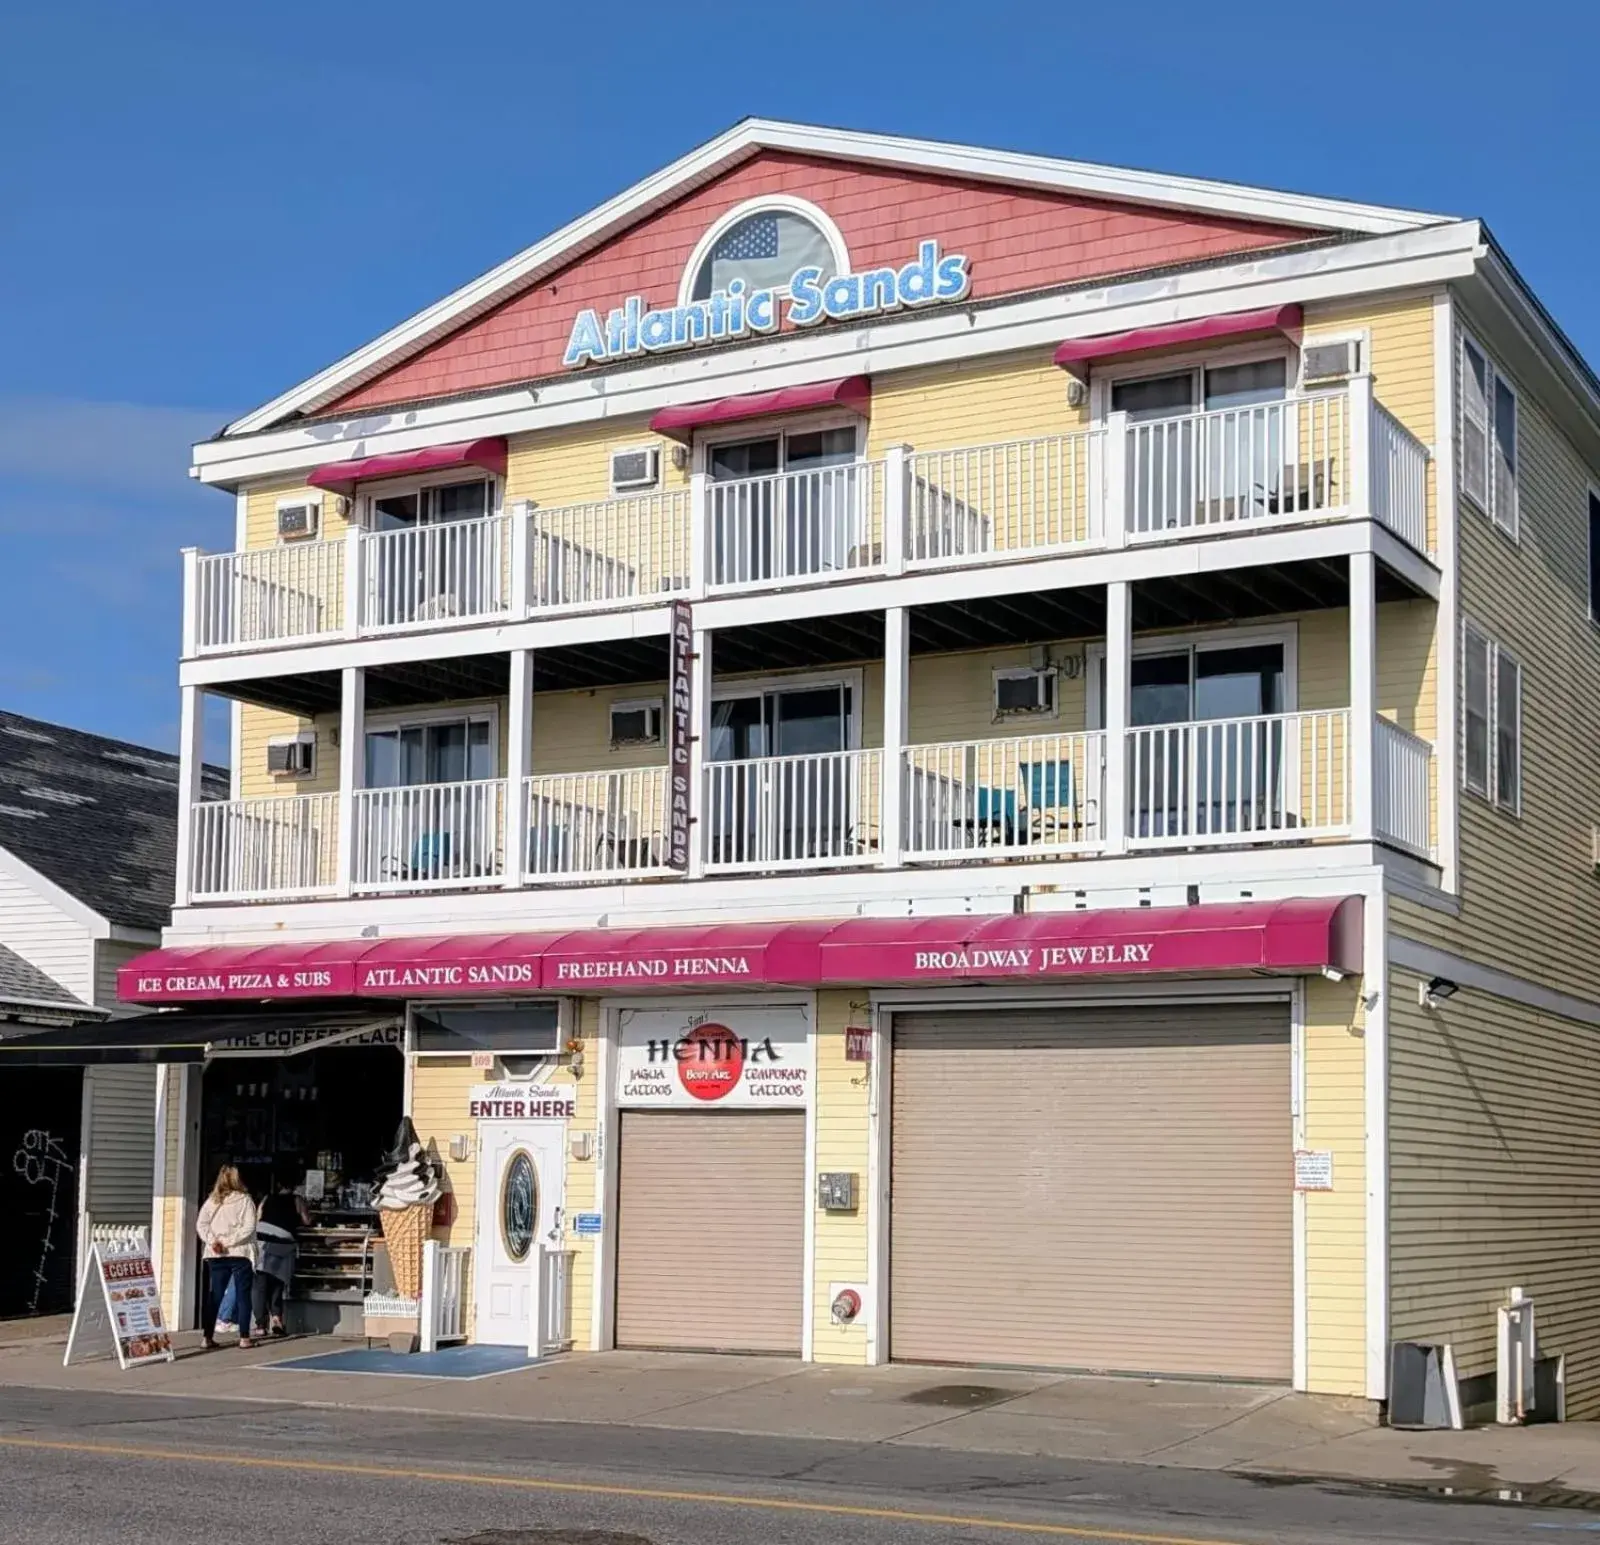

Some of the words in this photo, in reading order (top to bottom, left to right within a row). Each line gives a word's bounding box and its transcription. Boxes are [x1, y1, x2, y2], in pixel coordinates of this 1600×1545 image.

[562, 277, 777, 366] Atlantic
[787, 239, 970, 326] Sands
[673, 621, 690, 764] ATLANTIC
[672, 776, 688, 865] SANDS
[914, 948, 1034, 969] BROADWAY
[1039, 943, 1154, 971] JEWELRY
[364, 966, 462, 987] ATLANTIC
[468, 964, 532, 983] SANDS
[557, 959, 668, 980] FREEHAND
[674, 957, 750, 977] HENNA
[138, 977, 162, 992] ICE
[166, 976, 225, 993] CREAM,
[228, 974, 274, 990] PIZZA
[276, 974, 289, 988] &
[294, 971, 331, 987] SUBS
[647, 1037, 782, 1062] HENNA
[745, 1068, 807, 1081] TEMPORARY
[485, 1085, 525, 1099] Atlantic
[528, 1085, 560, 1098] Sands
[624, 1084, 672, 1096] TATTOOS
[749, 1084, 805, 1096] TATTOOS
[470, 1100, 525, 1116] ENTER
[530, 1100, 575, 1117] HERE
[109, 1260, 149, 1278] COFFEE
